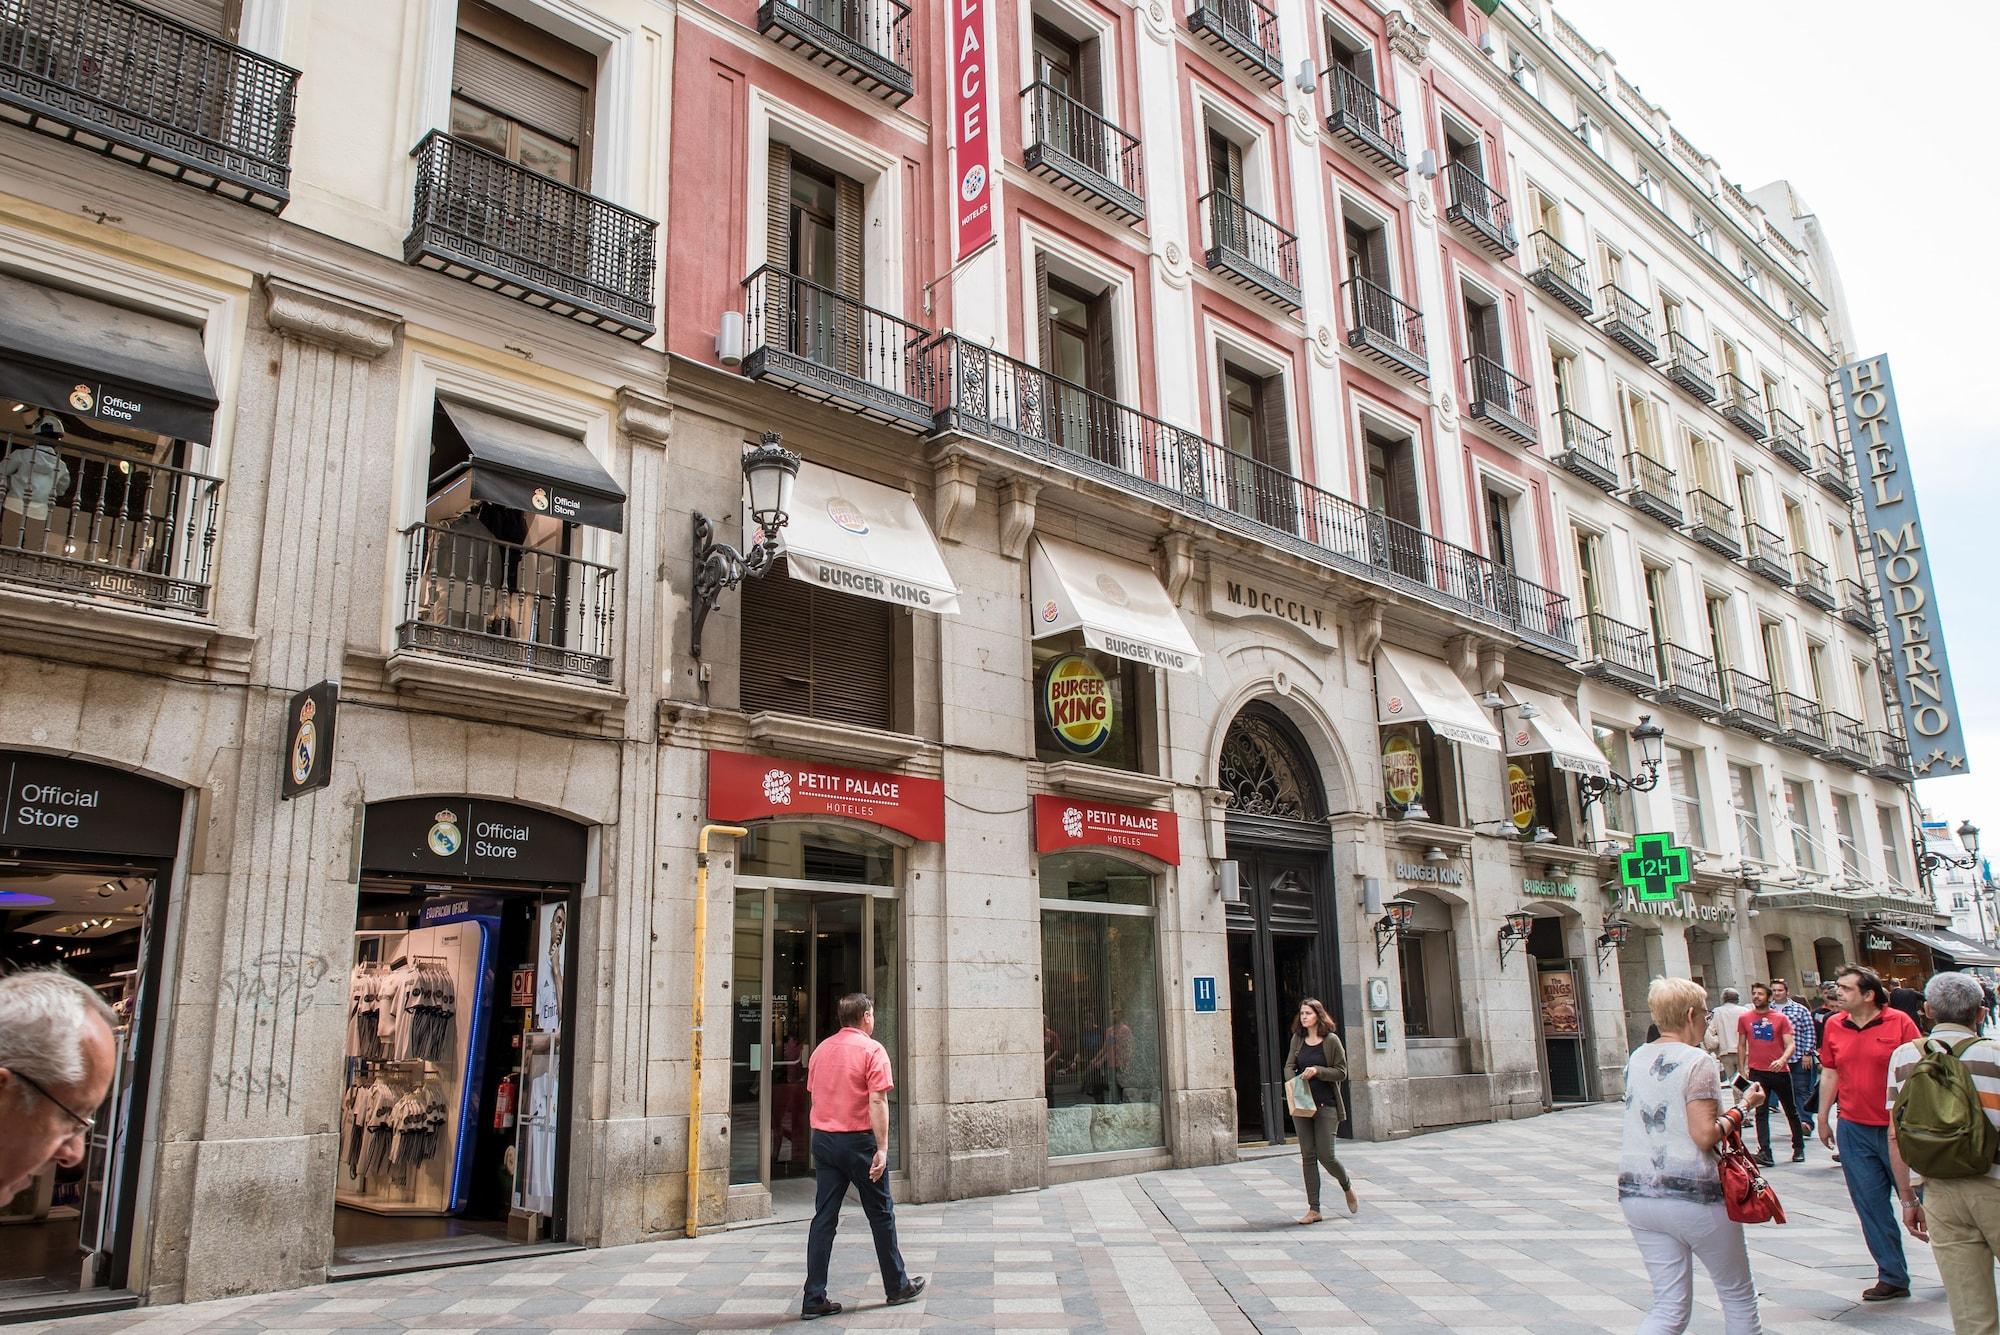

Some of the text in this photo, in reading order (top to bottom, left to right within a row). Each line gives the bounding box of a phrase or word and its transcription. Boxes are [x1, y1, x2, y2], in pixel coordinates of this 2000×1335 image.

[961, 203, 988, 227] HOTELES
[101, 405, 132, 421] Store
[102, 395, 141, 413] Official
[553, 496, 581, 510] Official
[553, 504, 576, 517] Store
[1847, 359, 1950, 737] HOTEL MODERNO
[819, 565, 931, 605] BURGER KING
[1105, 636, 1184, 669] BURGER KING
[1051, 678, 1105, 700] BURGER
[1052, 696, 1107, 728] KING
[1386, 753, 1417, 767] BURGER
[799, 772, 899, 798] PETIT PALACE
[1386, 767, 1418, 789] KING
[21, 784, 99, 807] Official
[18, 806, 79, 829] Store
[826, 802, 875, 816] HOTELES
[1086, 809, 1159, 831] PETIT PALACE
[475, 821, 529, 841] Official
[1107, 834, 1141, 846] HOTELES
[474, 841, 517, 859] Store
[1397, 863, 1464, 887] BURGER KING
[1638, 858, 1671, 876] 12H
[1523, 879, 1578, 899] BURGER KING
[1199, 980, 1211, 1000] H
[1544, 984, 1571, 995] KINGS
